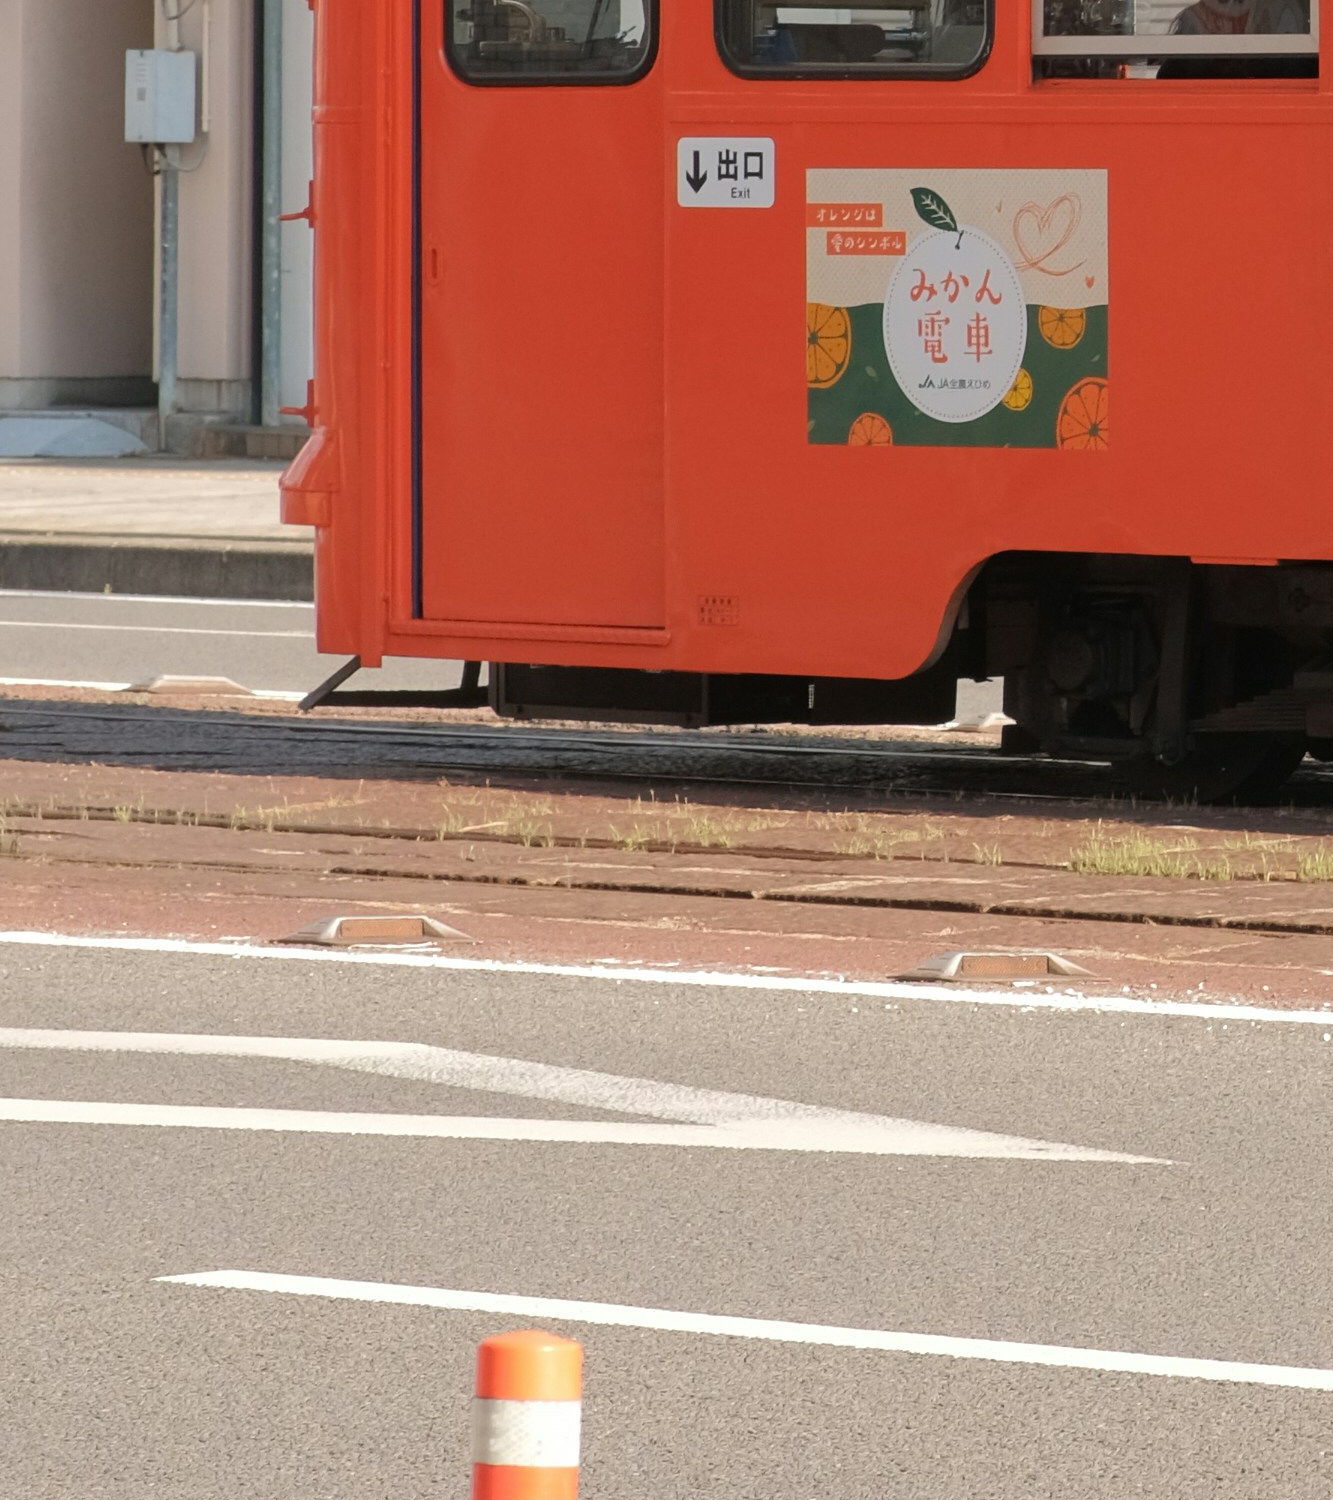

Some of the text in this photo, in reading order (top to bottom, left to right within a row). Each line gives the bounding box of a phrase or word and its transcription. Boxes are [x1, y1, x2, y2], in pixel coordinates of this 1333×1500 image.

[718, 149, 763, 181] 出口
[731, 187, 750, 198] Exit
[816, 206, 877, 221] オレンジは
[830, 233, 902, 253] 愛のシンボル
[910, 268, 1002, 303] みかん
[918, 310, 993, 363] 電車
